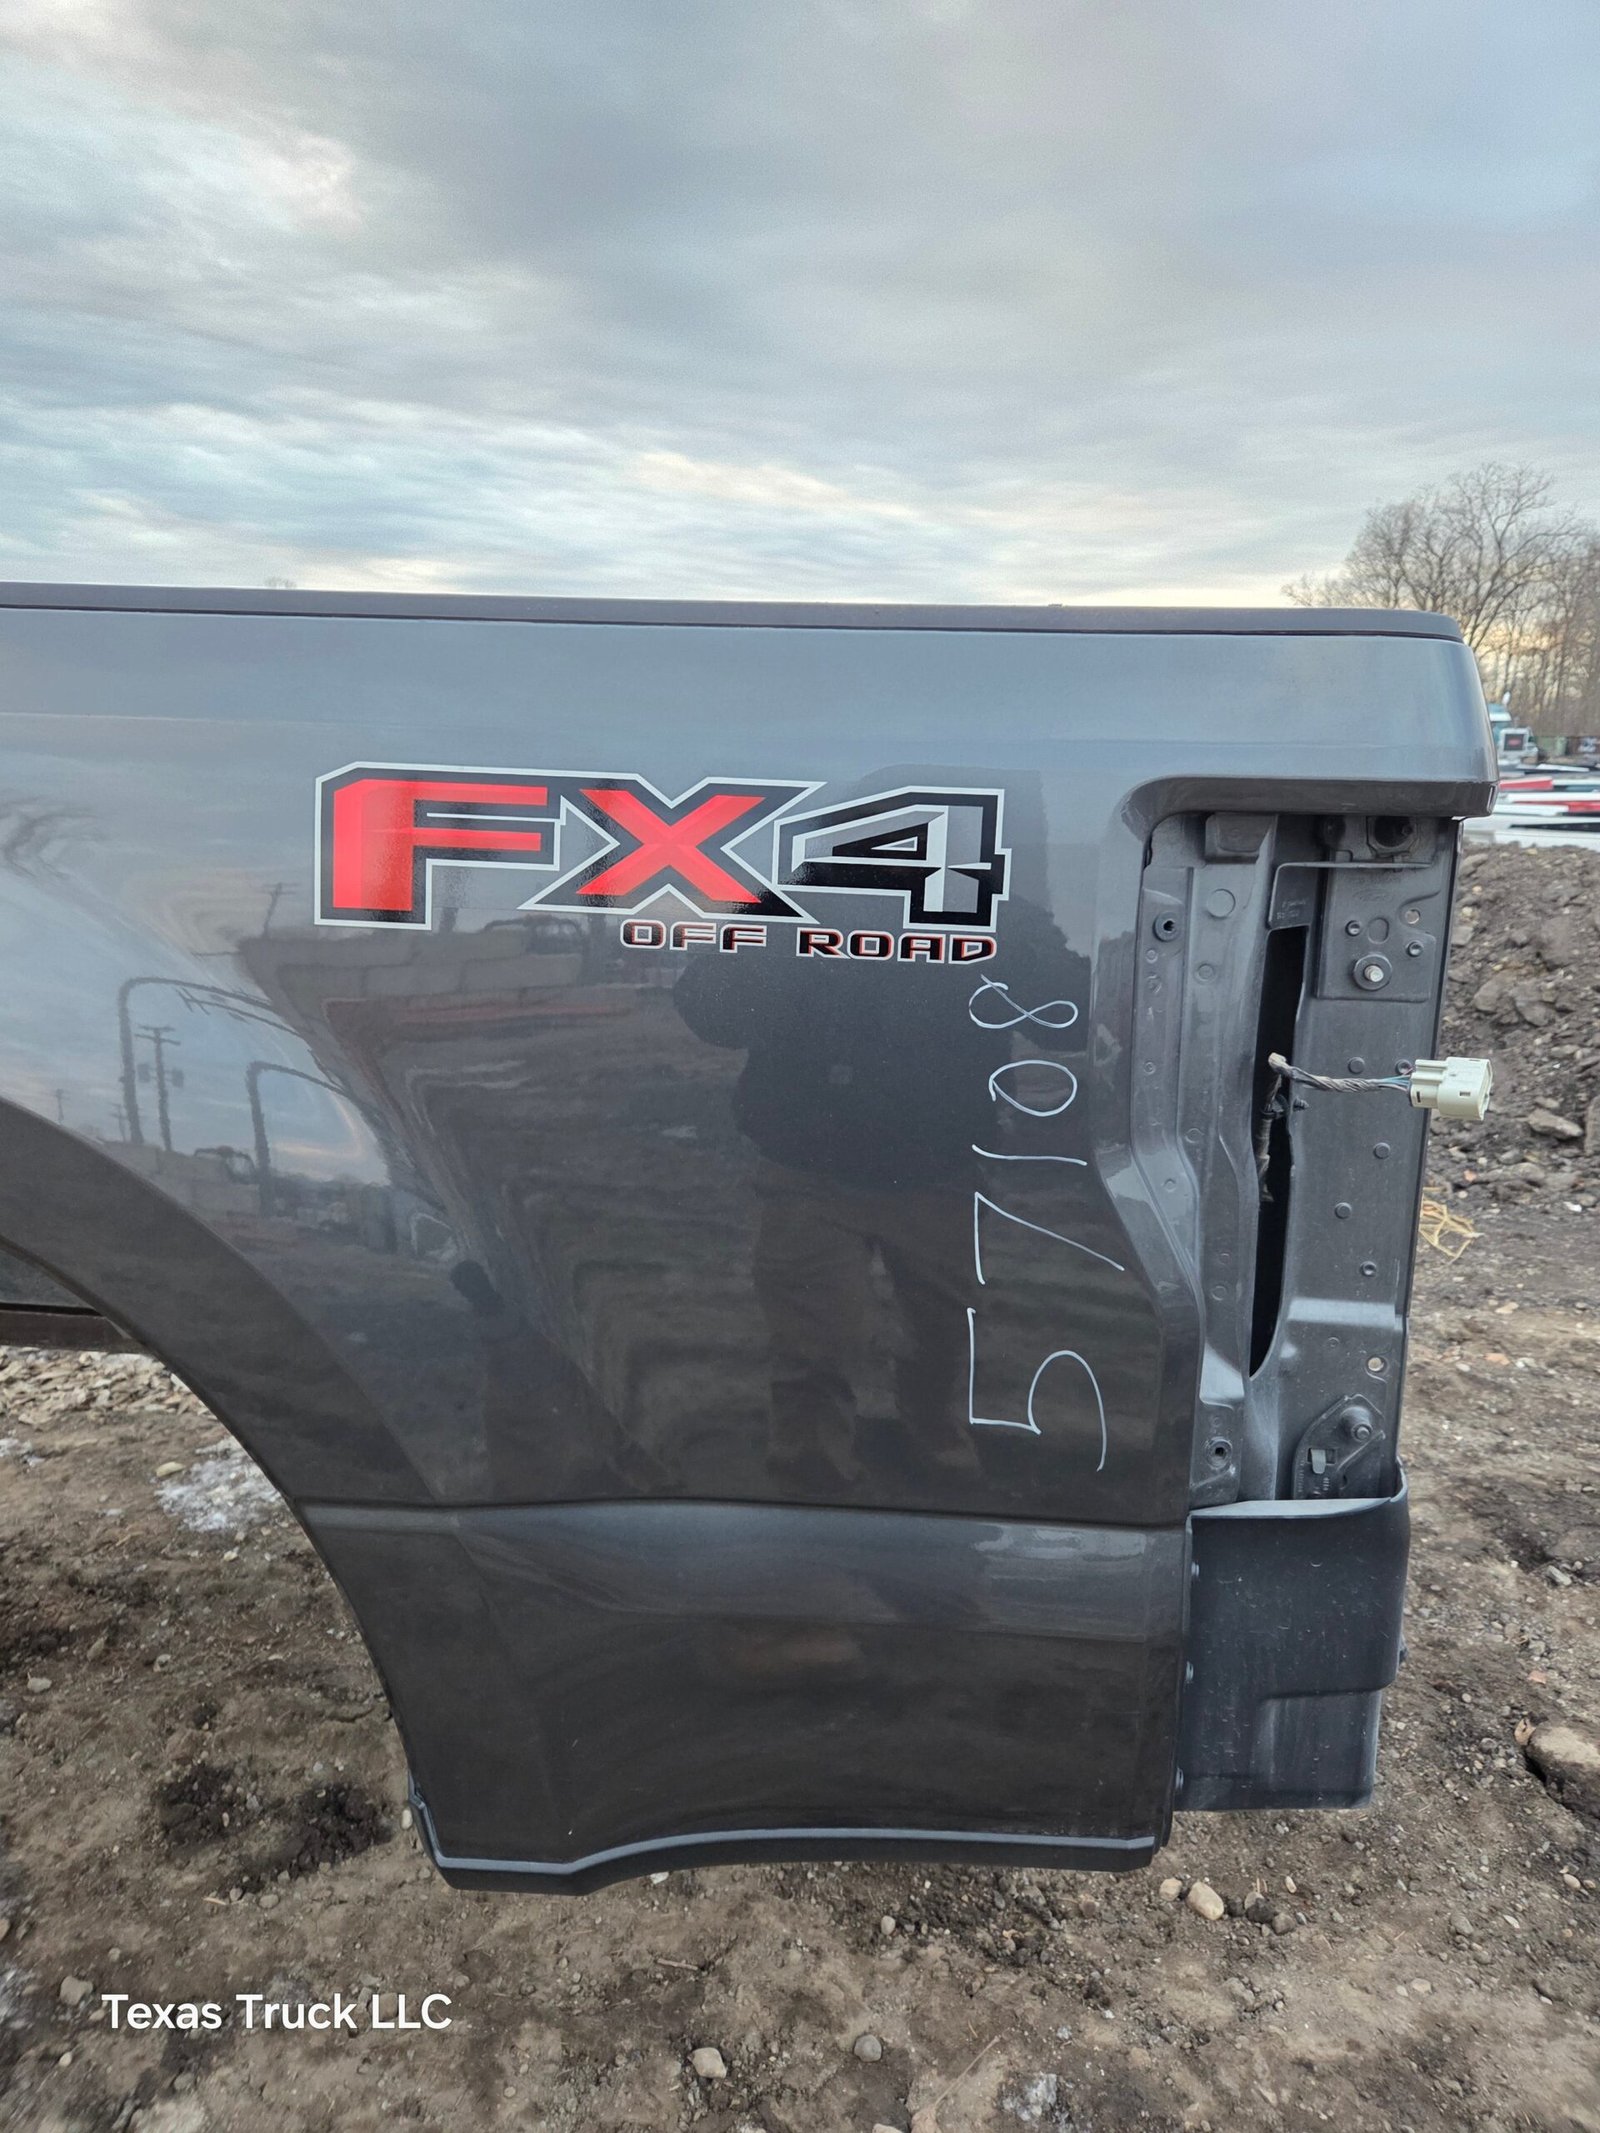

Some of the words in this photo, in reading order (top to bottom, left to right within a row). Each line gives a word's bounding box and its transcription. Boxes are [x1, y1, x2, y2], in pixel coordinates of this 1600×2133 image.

[314, 761, 1012, 933] FX4
[620, 920, 767, 954] OFF
[796, 926, 998, 965] ROAD
[968, 973, 1125, 1473] 57108
